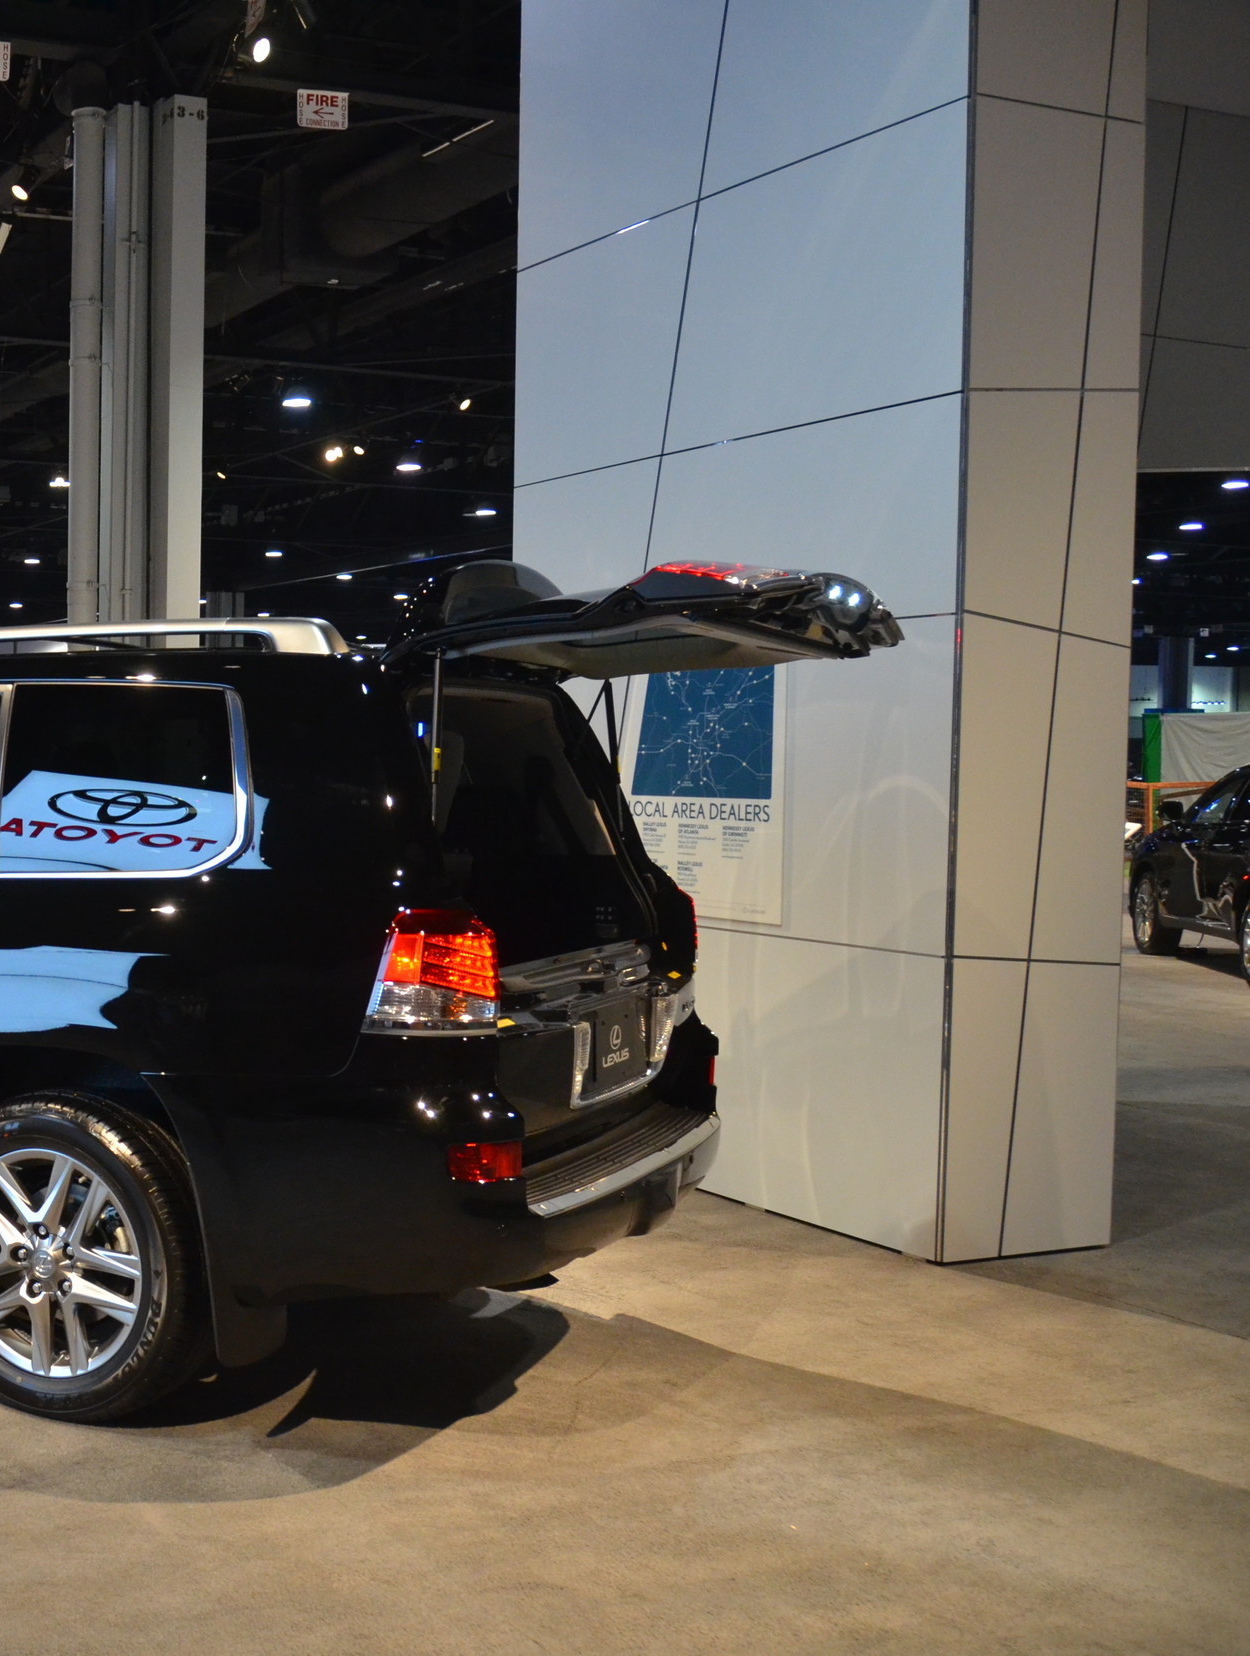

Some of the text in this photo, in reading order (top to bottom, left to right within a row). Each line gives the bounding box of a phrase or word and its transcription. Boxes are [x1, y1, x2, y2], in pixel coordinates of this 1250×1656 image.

[306, 93, 339, 108] FIRE
[305, 118, 340, 128] CONNECTION
[671, 802, 706, 819] AREA
[709, 803, 770, 823] DEALERS
[602, 1047, 630, 1068] LEXUS
